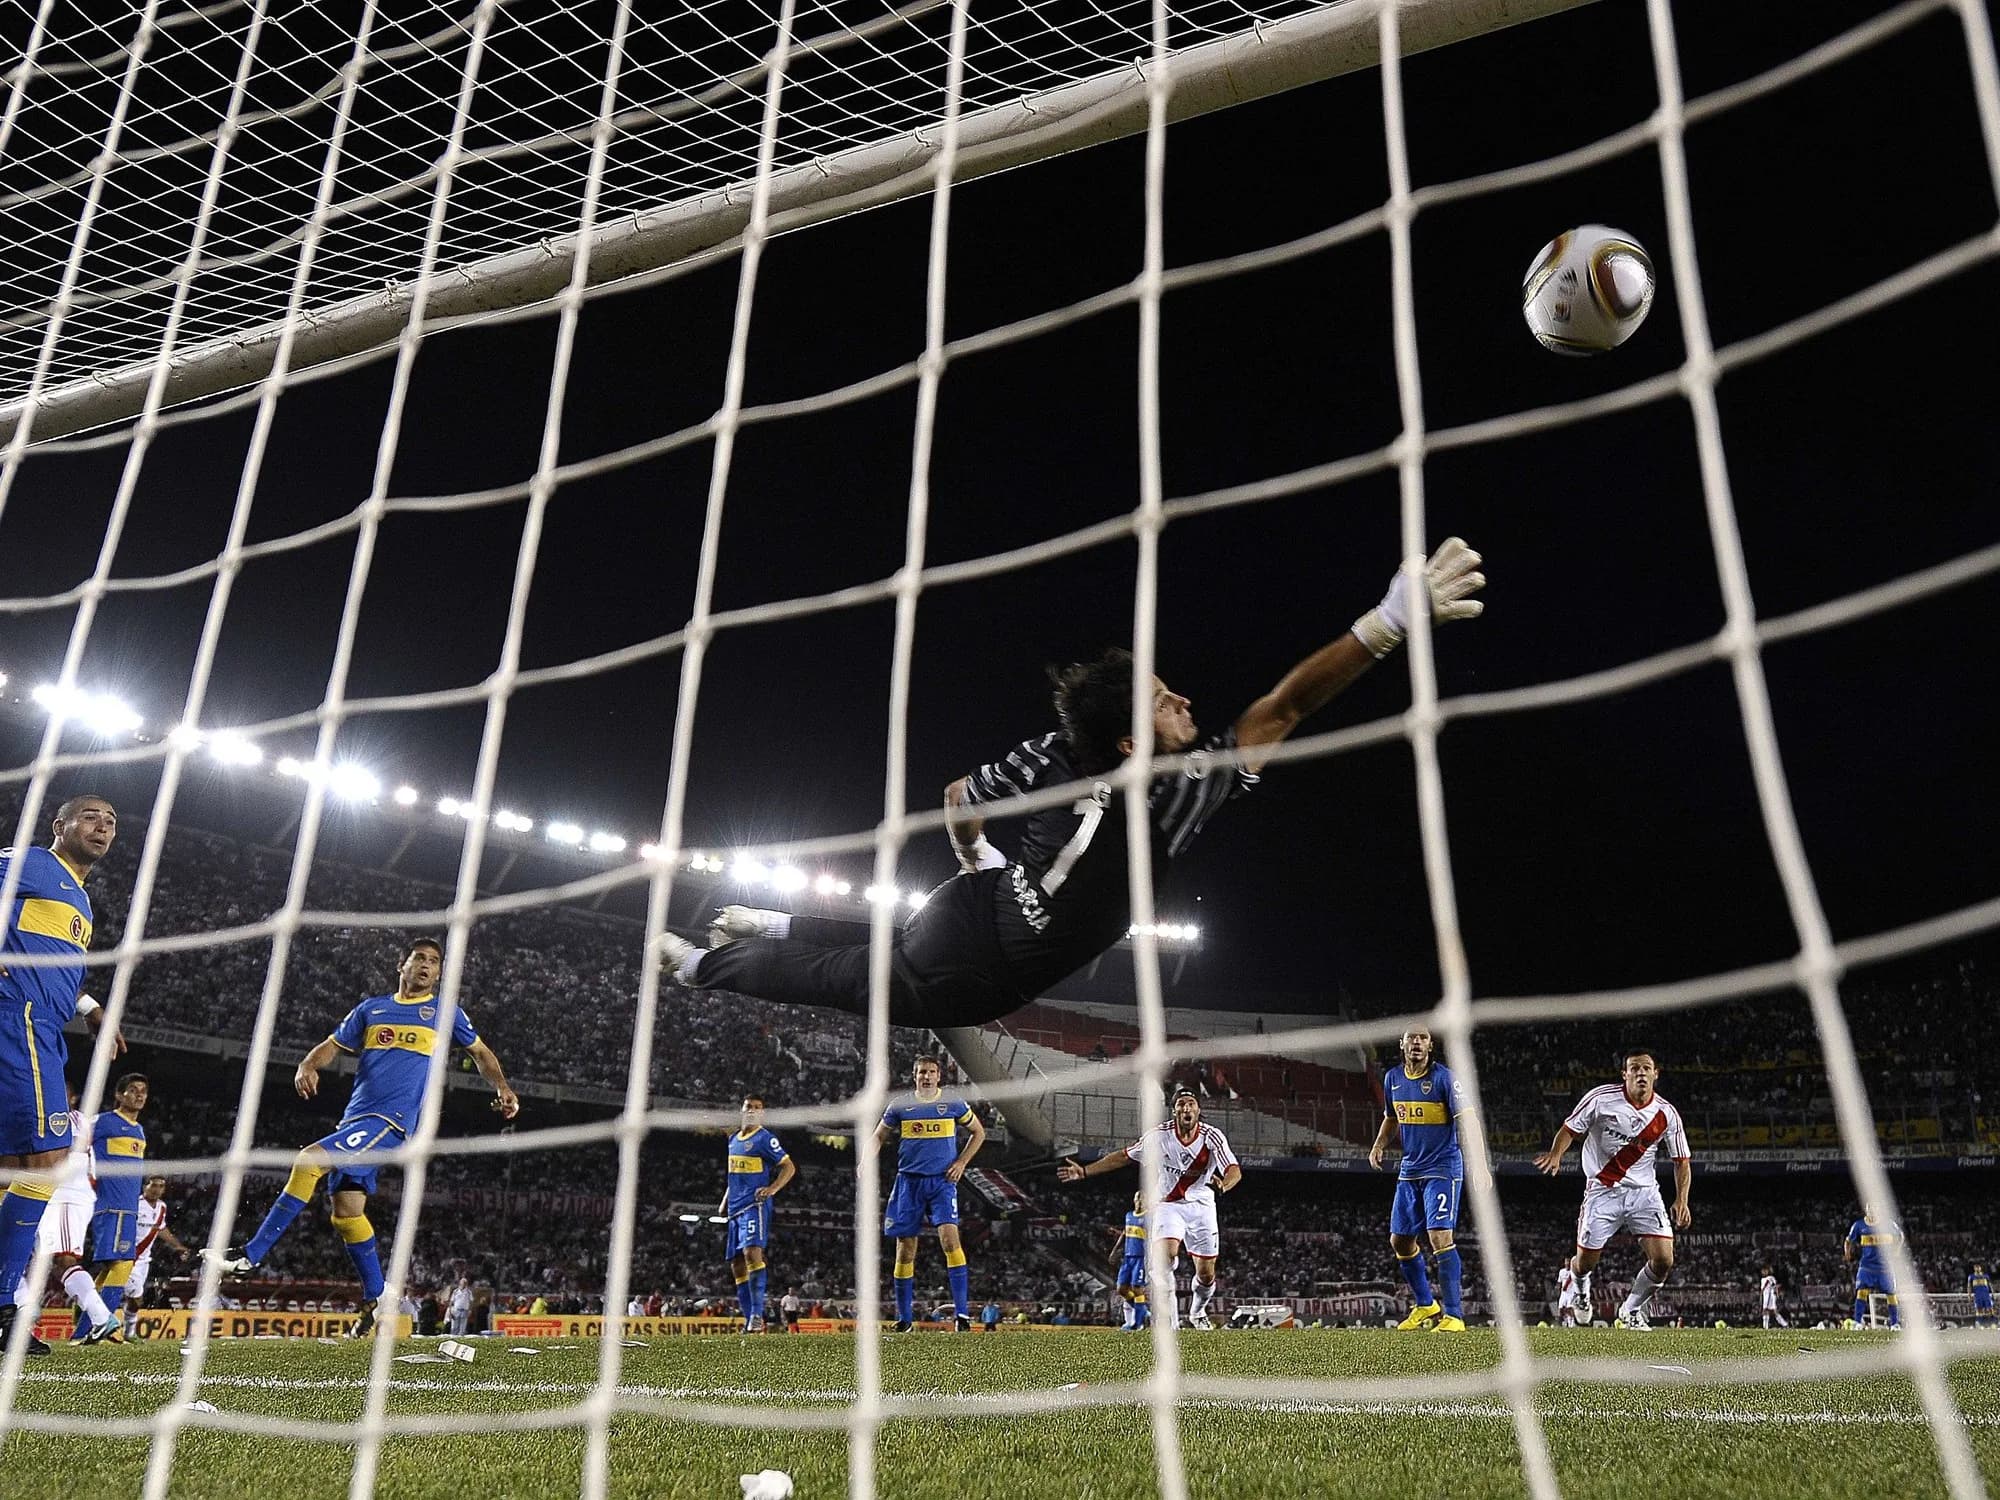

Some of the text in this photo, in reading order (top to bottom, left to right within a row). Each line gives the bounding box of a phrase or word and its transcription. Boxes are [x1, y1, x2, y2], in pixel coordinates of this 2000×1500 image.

[1040, 798, 1106, 899] 1
[397, 1033, 417, 1044] LG
[1409, 1107, 1424, 1118] LG
[926, 1123, 940, 1133] LG
[346, 1131, 368, 1148] 6
[1241, 1158, 1274, 1169] Fibertel
[1317, 1160, 1350, 1170] Fibertel
[1704, 1162, 1739, 1173] Fibertel
[1786, 1161, 1823, 1172] Fibertel
[1957, 1156, 1996, 1169] Fibertel
[1436, 1193, 1449, 1213] 2
[746, 1219, 757, 1234] 5
[569, 1322, 581, 1337] 6
[657, 1322, 683, 1336] SIN
